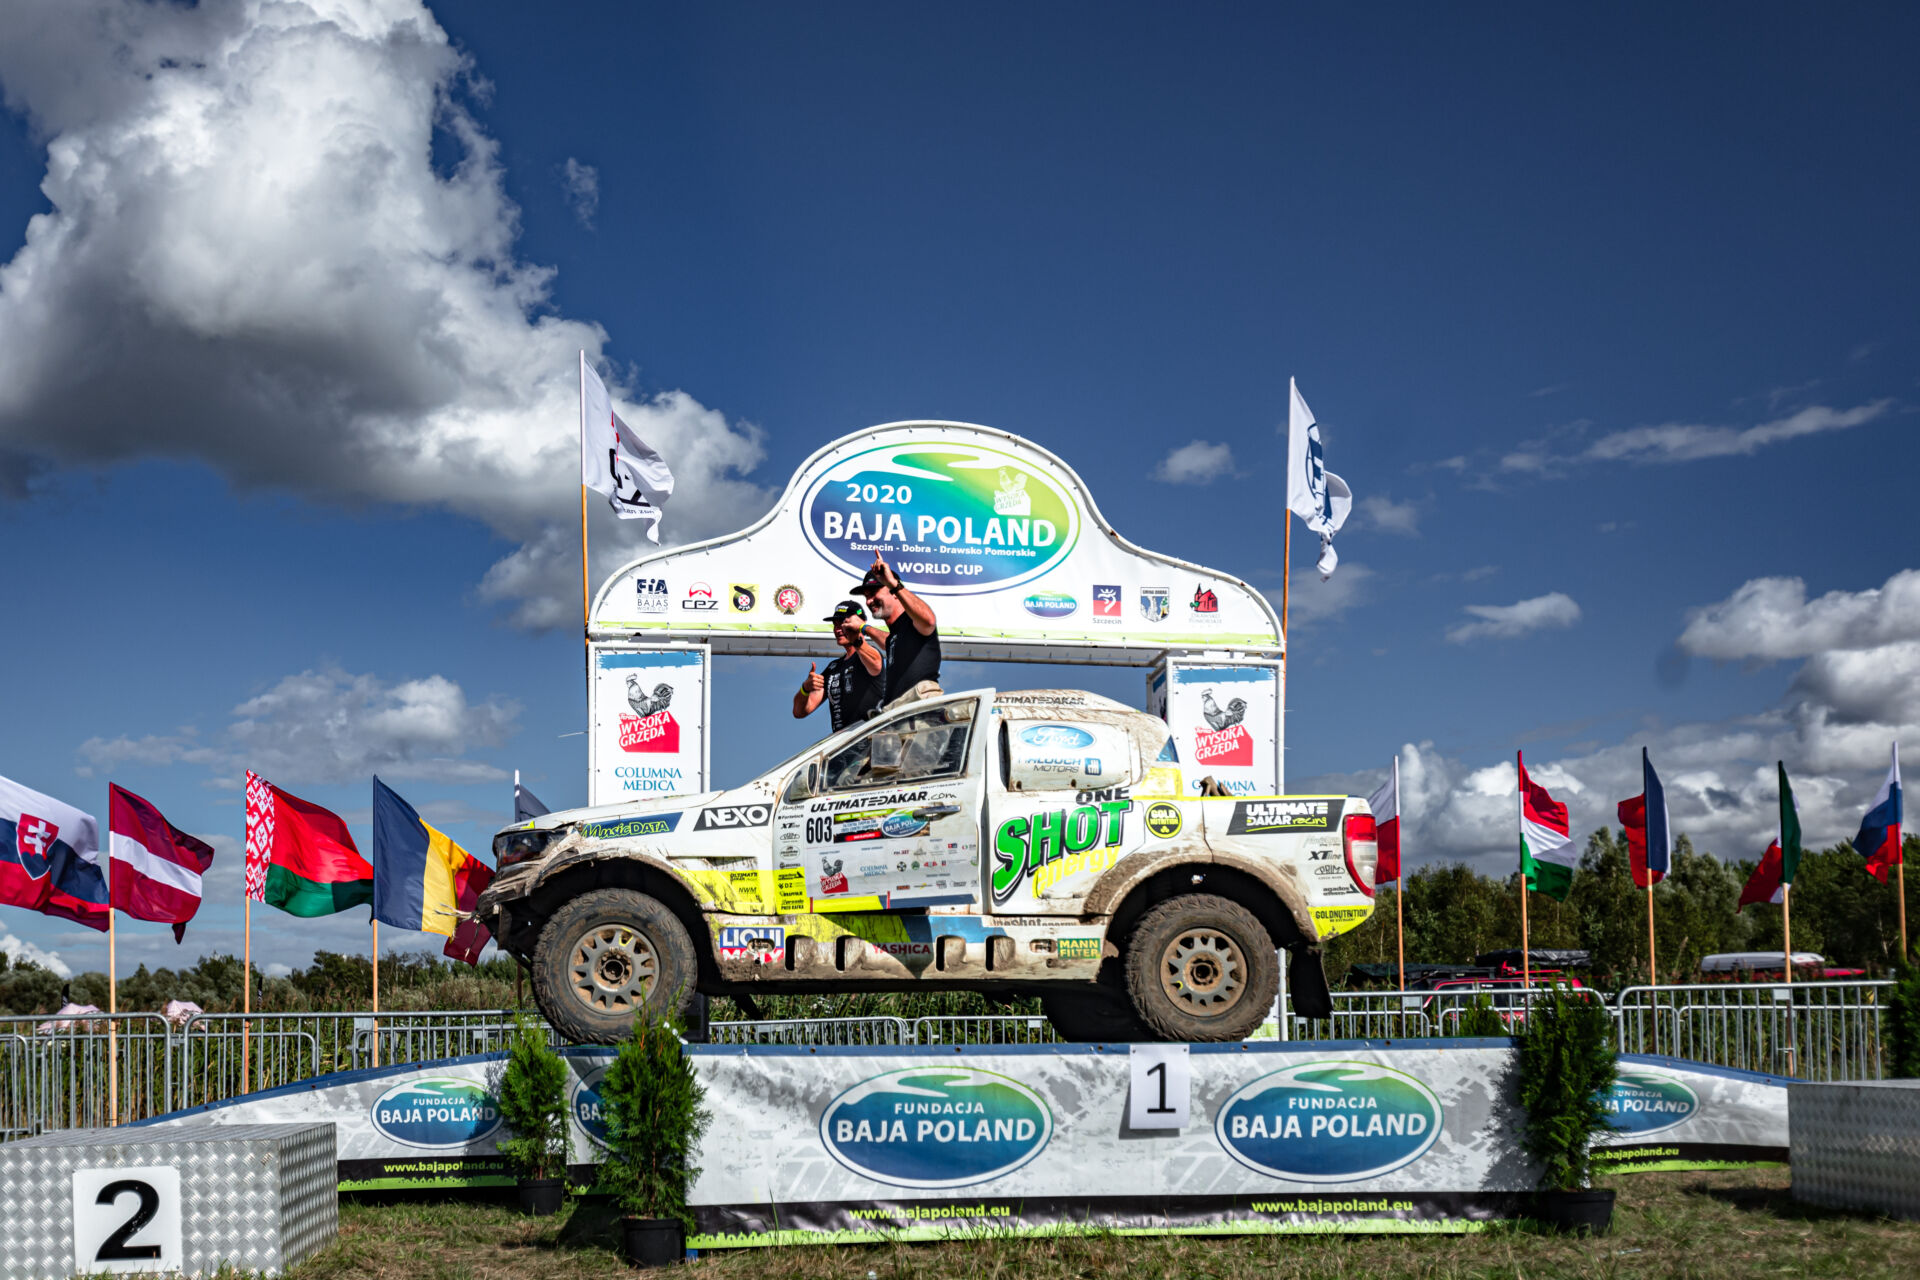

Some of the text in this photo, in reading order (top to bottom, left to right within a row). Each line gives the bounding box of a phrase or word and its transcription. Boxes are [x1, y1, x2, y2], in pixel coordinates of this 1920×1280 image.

[846, 483, 912, 505] 2020
[824, 511, 1056, 548] BAJA POLAND
[850, 542, 893, 552] Szczecin
[902, 544, 931, 553] Dobra
[940, 546, 982, 555] Drawsko
[985, 548, 1036, 557] Pomorskie
[897, 562, 983, 575] WORLD CUP
[637, 599, 669, 607] BAJAS
[1025, 600, 1076, 609] BAJA POLAND
[1092, 617, 1122, 625] Szczecin
[620, 711, 671, 735] WYSOKA
[620, 726, 666, 747] GRZĘDA
[1033, 727, 1080, 745] Ford
[1196, 726, 1245, 748] WYSOKA
[1195, 740, 1240, 760] GRZĘDA
[615, 767, 682, 779] COLUMNA
[1033, 765, 1080, 773] MOTORS
[623, 780, 675, 791] MEDICA
[1076, 788, 1130, 805] ONE
[1246, 802, 1328, 815] ULTIMATE
[705, 806, 769, 828] NEXO
[1246, 815, 1327, 827] DAKAR racing
[806, 816, 832, 844] 603
[992, 800, 1132, 906] SHOT
[1033, 845, 1121, 898] energy
[738, 886, 757, 894] NWM
[1315, 909, 1368, 919] GOLDNUTRITION
[872, 943, 931, 955] YASHICA
[1060, 940, 1099, 949] MANN
[1060, 949, 1099, 958] FILTER
[1147, 1062, 1177, 1114] 1
[1613, 1089, 1663, 1098] FUNDACJA
[412, 1097, 466, 1106] FUNDACJA
[894, 1102, 985, 1114] FUNDACJA
[1288, 1097, 1378, 1109] FUNDACJA
[1623, 1098, 1691, 1113] POLAND
[380, 1107, 497, 1124] BAJA POLAND
[837, 1118, 1037, 1143] BAJA POLAND
[1231, 1113, 1428, 1139] BAJA POLAND
[384, 1161, 504, 1174] www.bajapoland.eu
[850, 1204, 1011, 1221] www.bajapoland.eu
[1251, 1199, 1413, 1215] www.bajapoland.eu
[95, 1180, 162, 1262] 2
